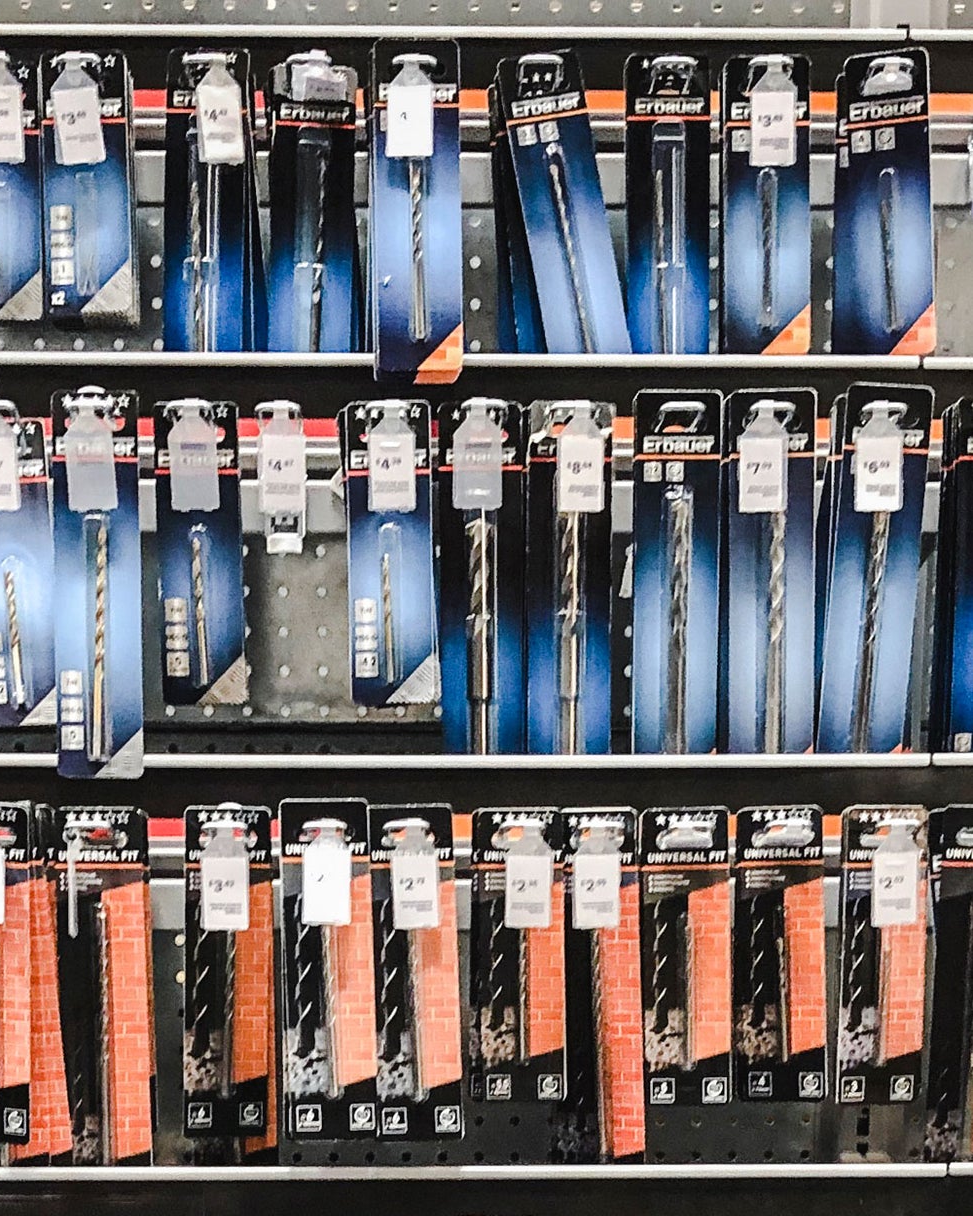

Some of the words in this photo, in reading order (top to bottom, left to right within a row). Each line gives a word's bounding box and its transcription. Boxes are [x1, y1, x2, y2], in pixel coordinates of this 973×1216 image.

[511, 98, 579, 119] Erbauer
[634, 100, 705, 114] Erbauer
[849, 100, 924, 121] Erbauer
[643, 435, 715, 453] Erbauer
[8, 848, 25, 861] FIT
[58, 849, 119, 863] UVERSAL
[121, 849, 139, 861] FIT
[646, 850, 707, 864] UNIVERSAL
[709, 850, 725, 862] FIT
[744, 847, 802, 860] UNIVERSAL
[804, 846, 820, 858] FIT
